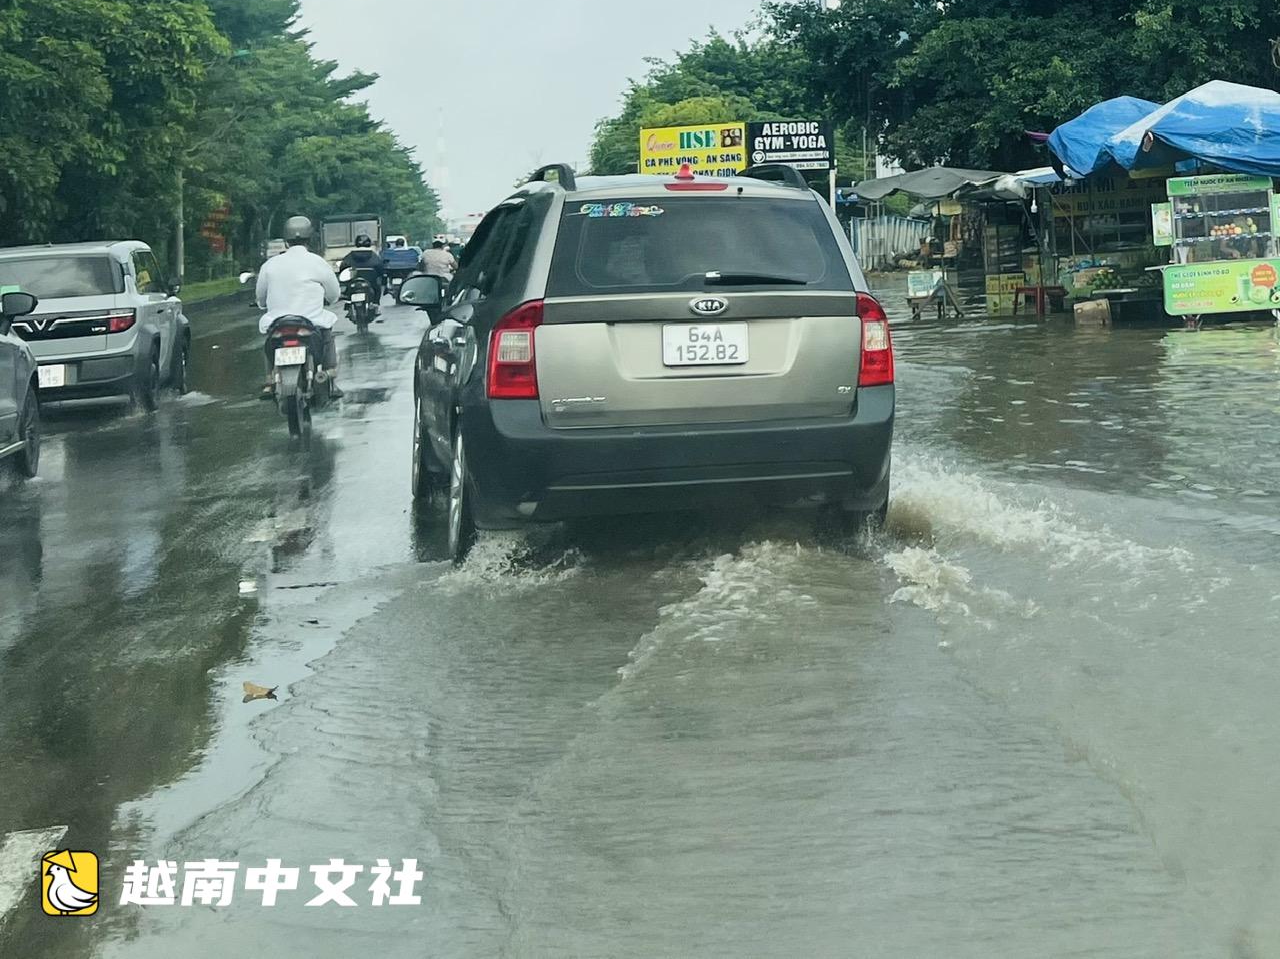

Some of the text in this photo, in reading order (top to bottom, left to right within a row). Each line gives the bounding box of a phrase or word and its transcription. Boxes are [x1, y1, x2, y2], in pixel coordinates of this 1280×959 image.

[762, 122, 819, 136] AEROBIC
[698, 300, 722, 311] KIA
[688, 327, 724, 343] 64A
[676, 344, 739, 362] 152.82
